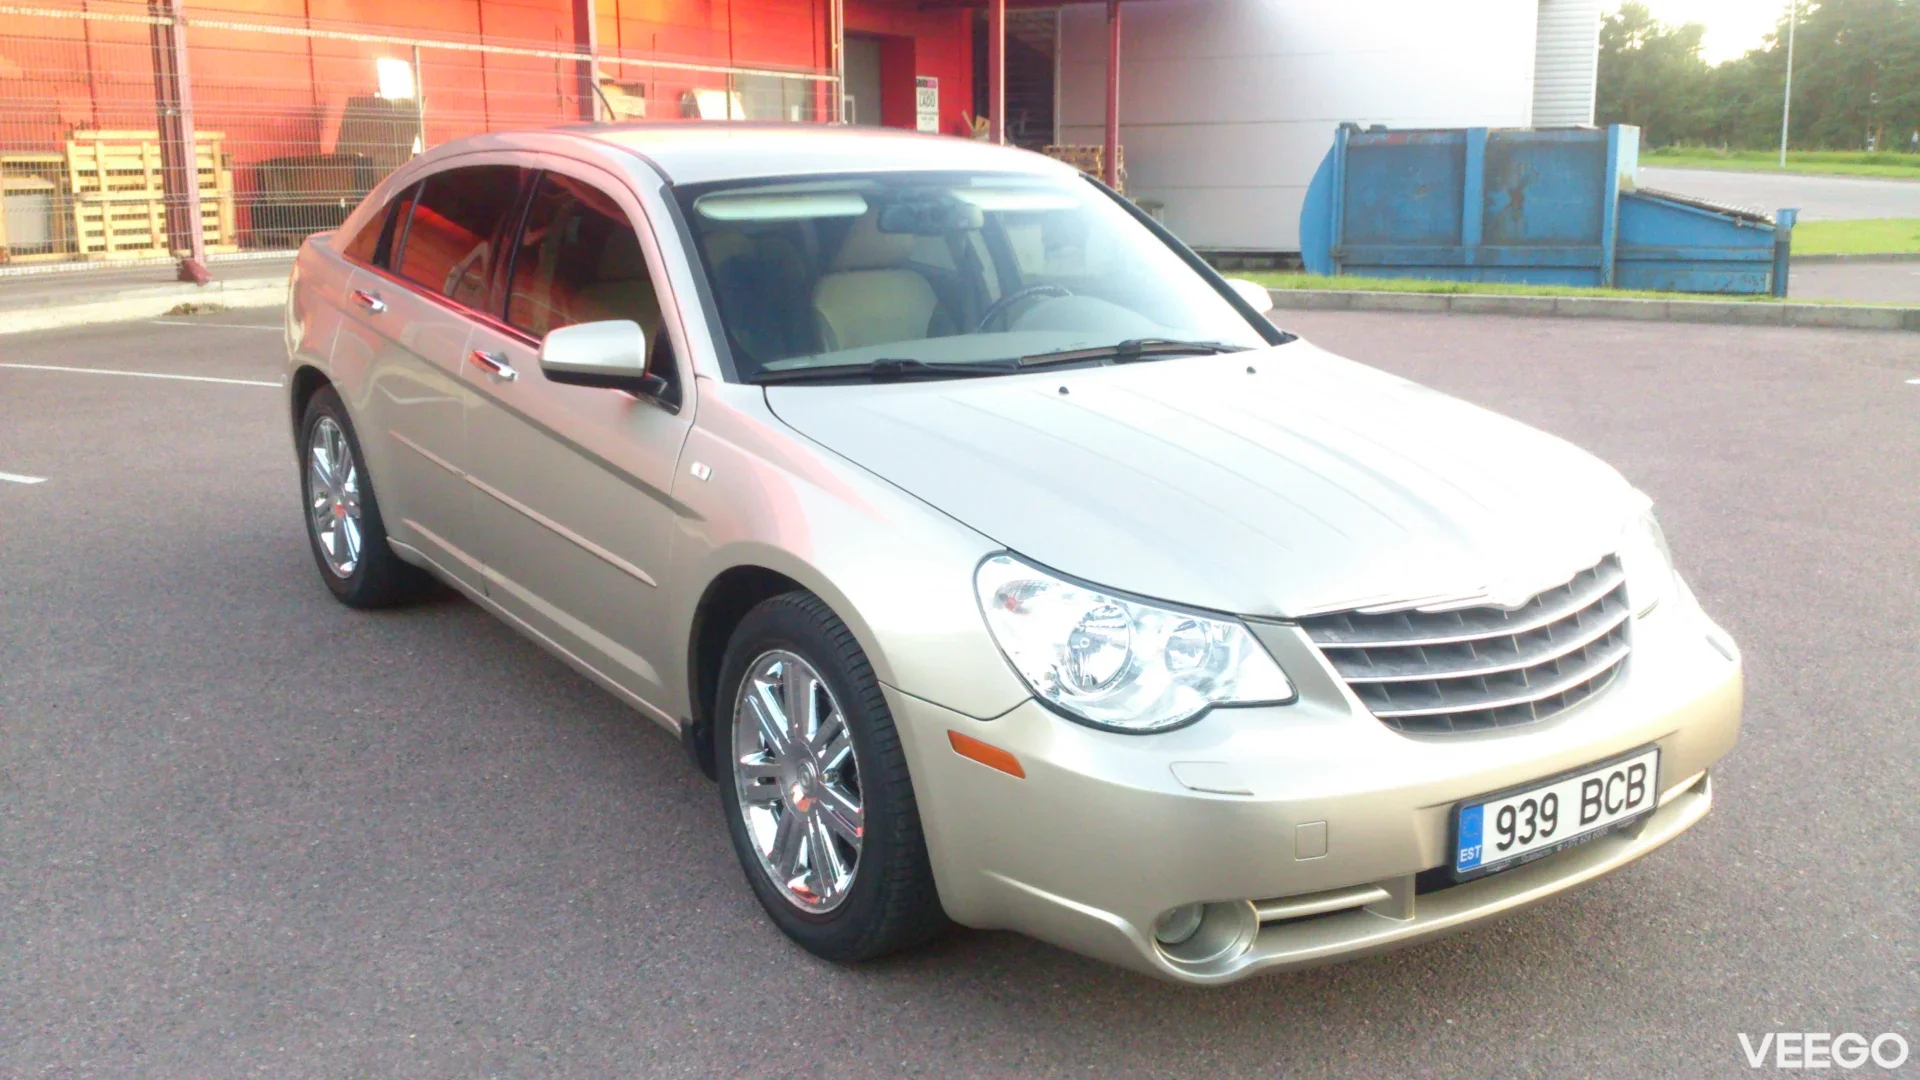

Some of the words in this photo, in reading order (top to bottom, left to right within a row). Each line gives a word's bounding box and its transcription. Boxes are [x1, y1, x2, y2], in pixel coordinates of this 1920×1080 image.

[1496, 792, 1559, 851] 939
[1580, 762, 1646, 826] BCB
[1460, 844, 1482, 863] EST
